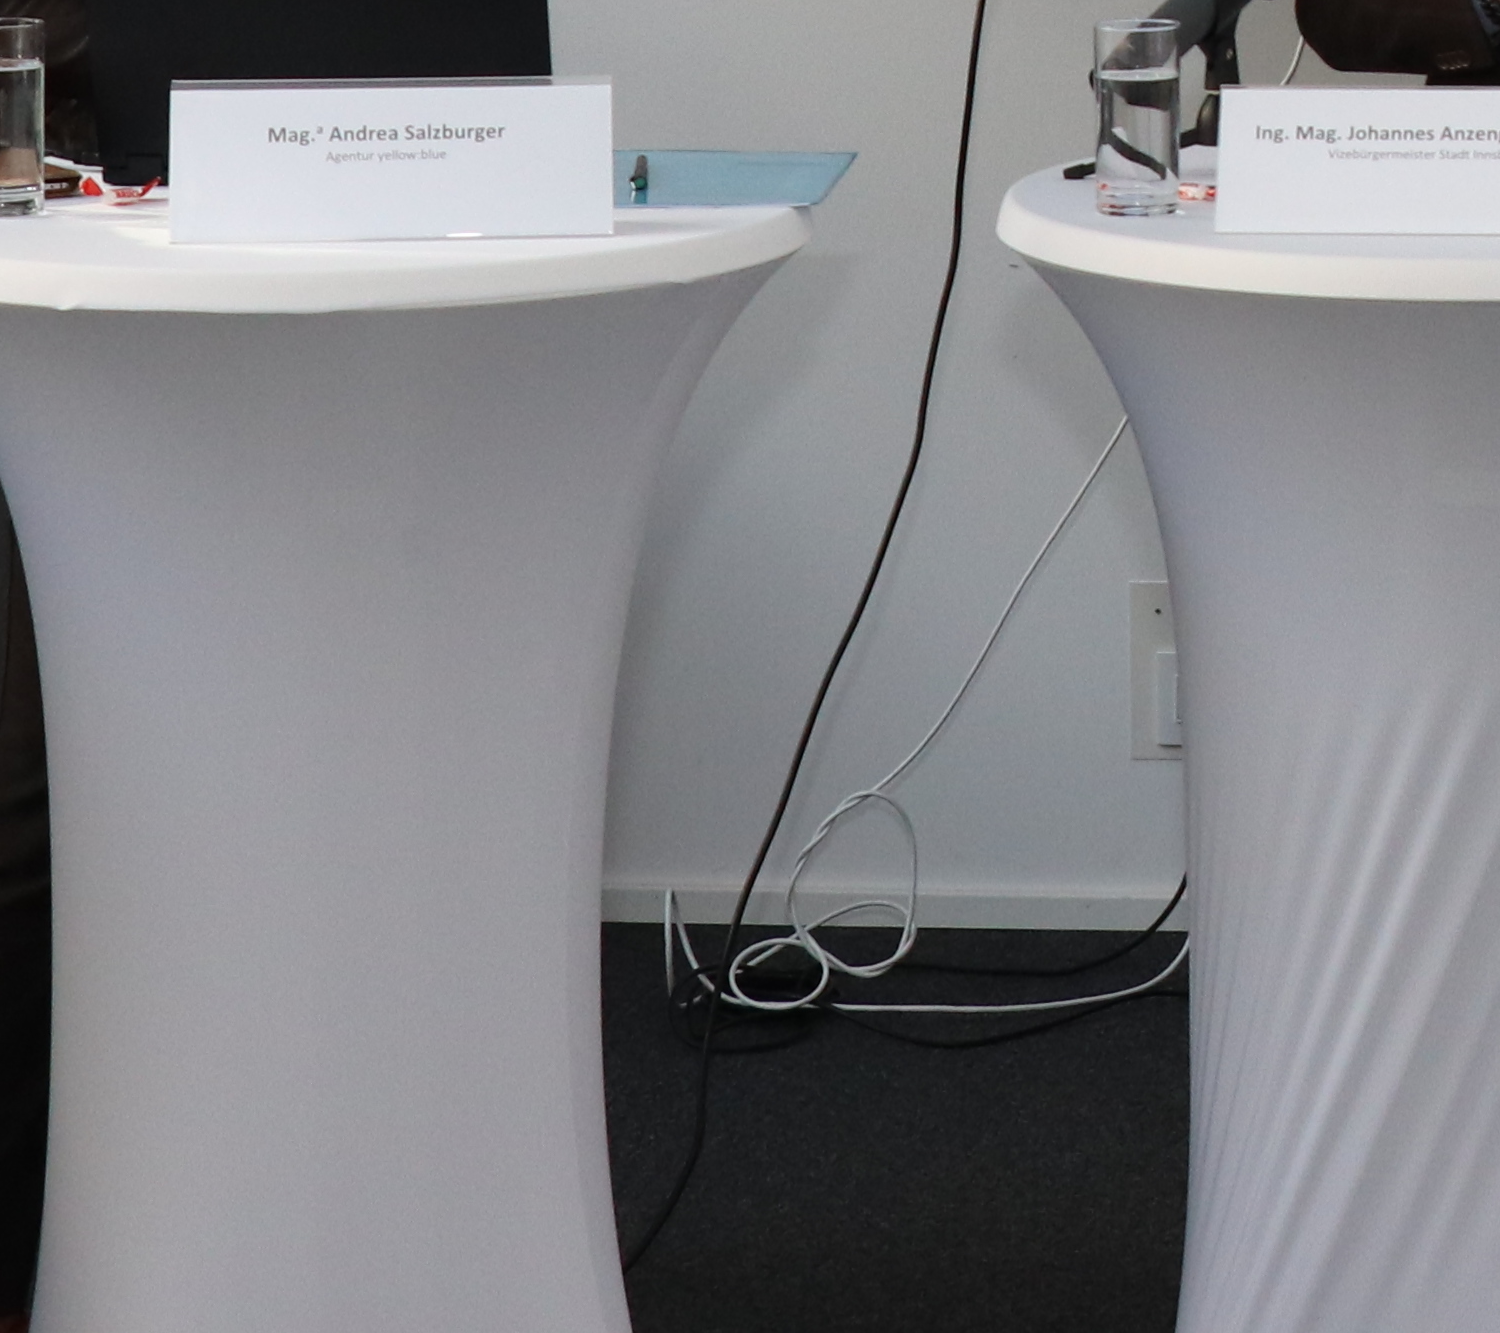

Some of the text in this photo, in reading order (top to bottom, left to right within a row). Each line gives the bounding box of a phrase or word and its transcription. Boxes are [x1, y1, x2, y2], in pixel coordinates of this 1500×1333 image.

[329, 125, 399, 143] Andrea
[404, 123, 506, 143] Salzburger
[1256, 125, 1289, 144] Ing.
[1295, 125, 1342, 144] Mag.
[1348, 125, 1435, 142] Johannes
[326, 151, 374, 164] Agentur
[1328, 149, 1436, 162] Vizebürgermeister
[1439, 149, 1470, 161] Stadt
